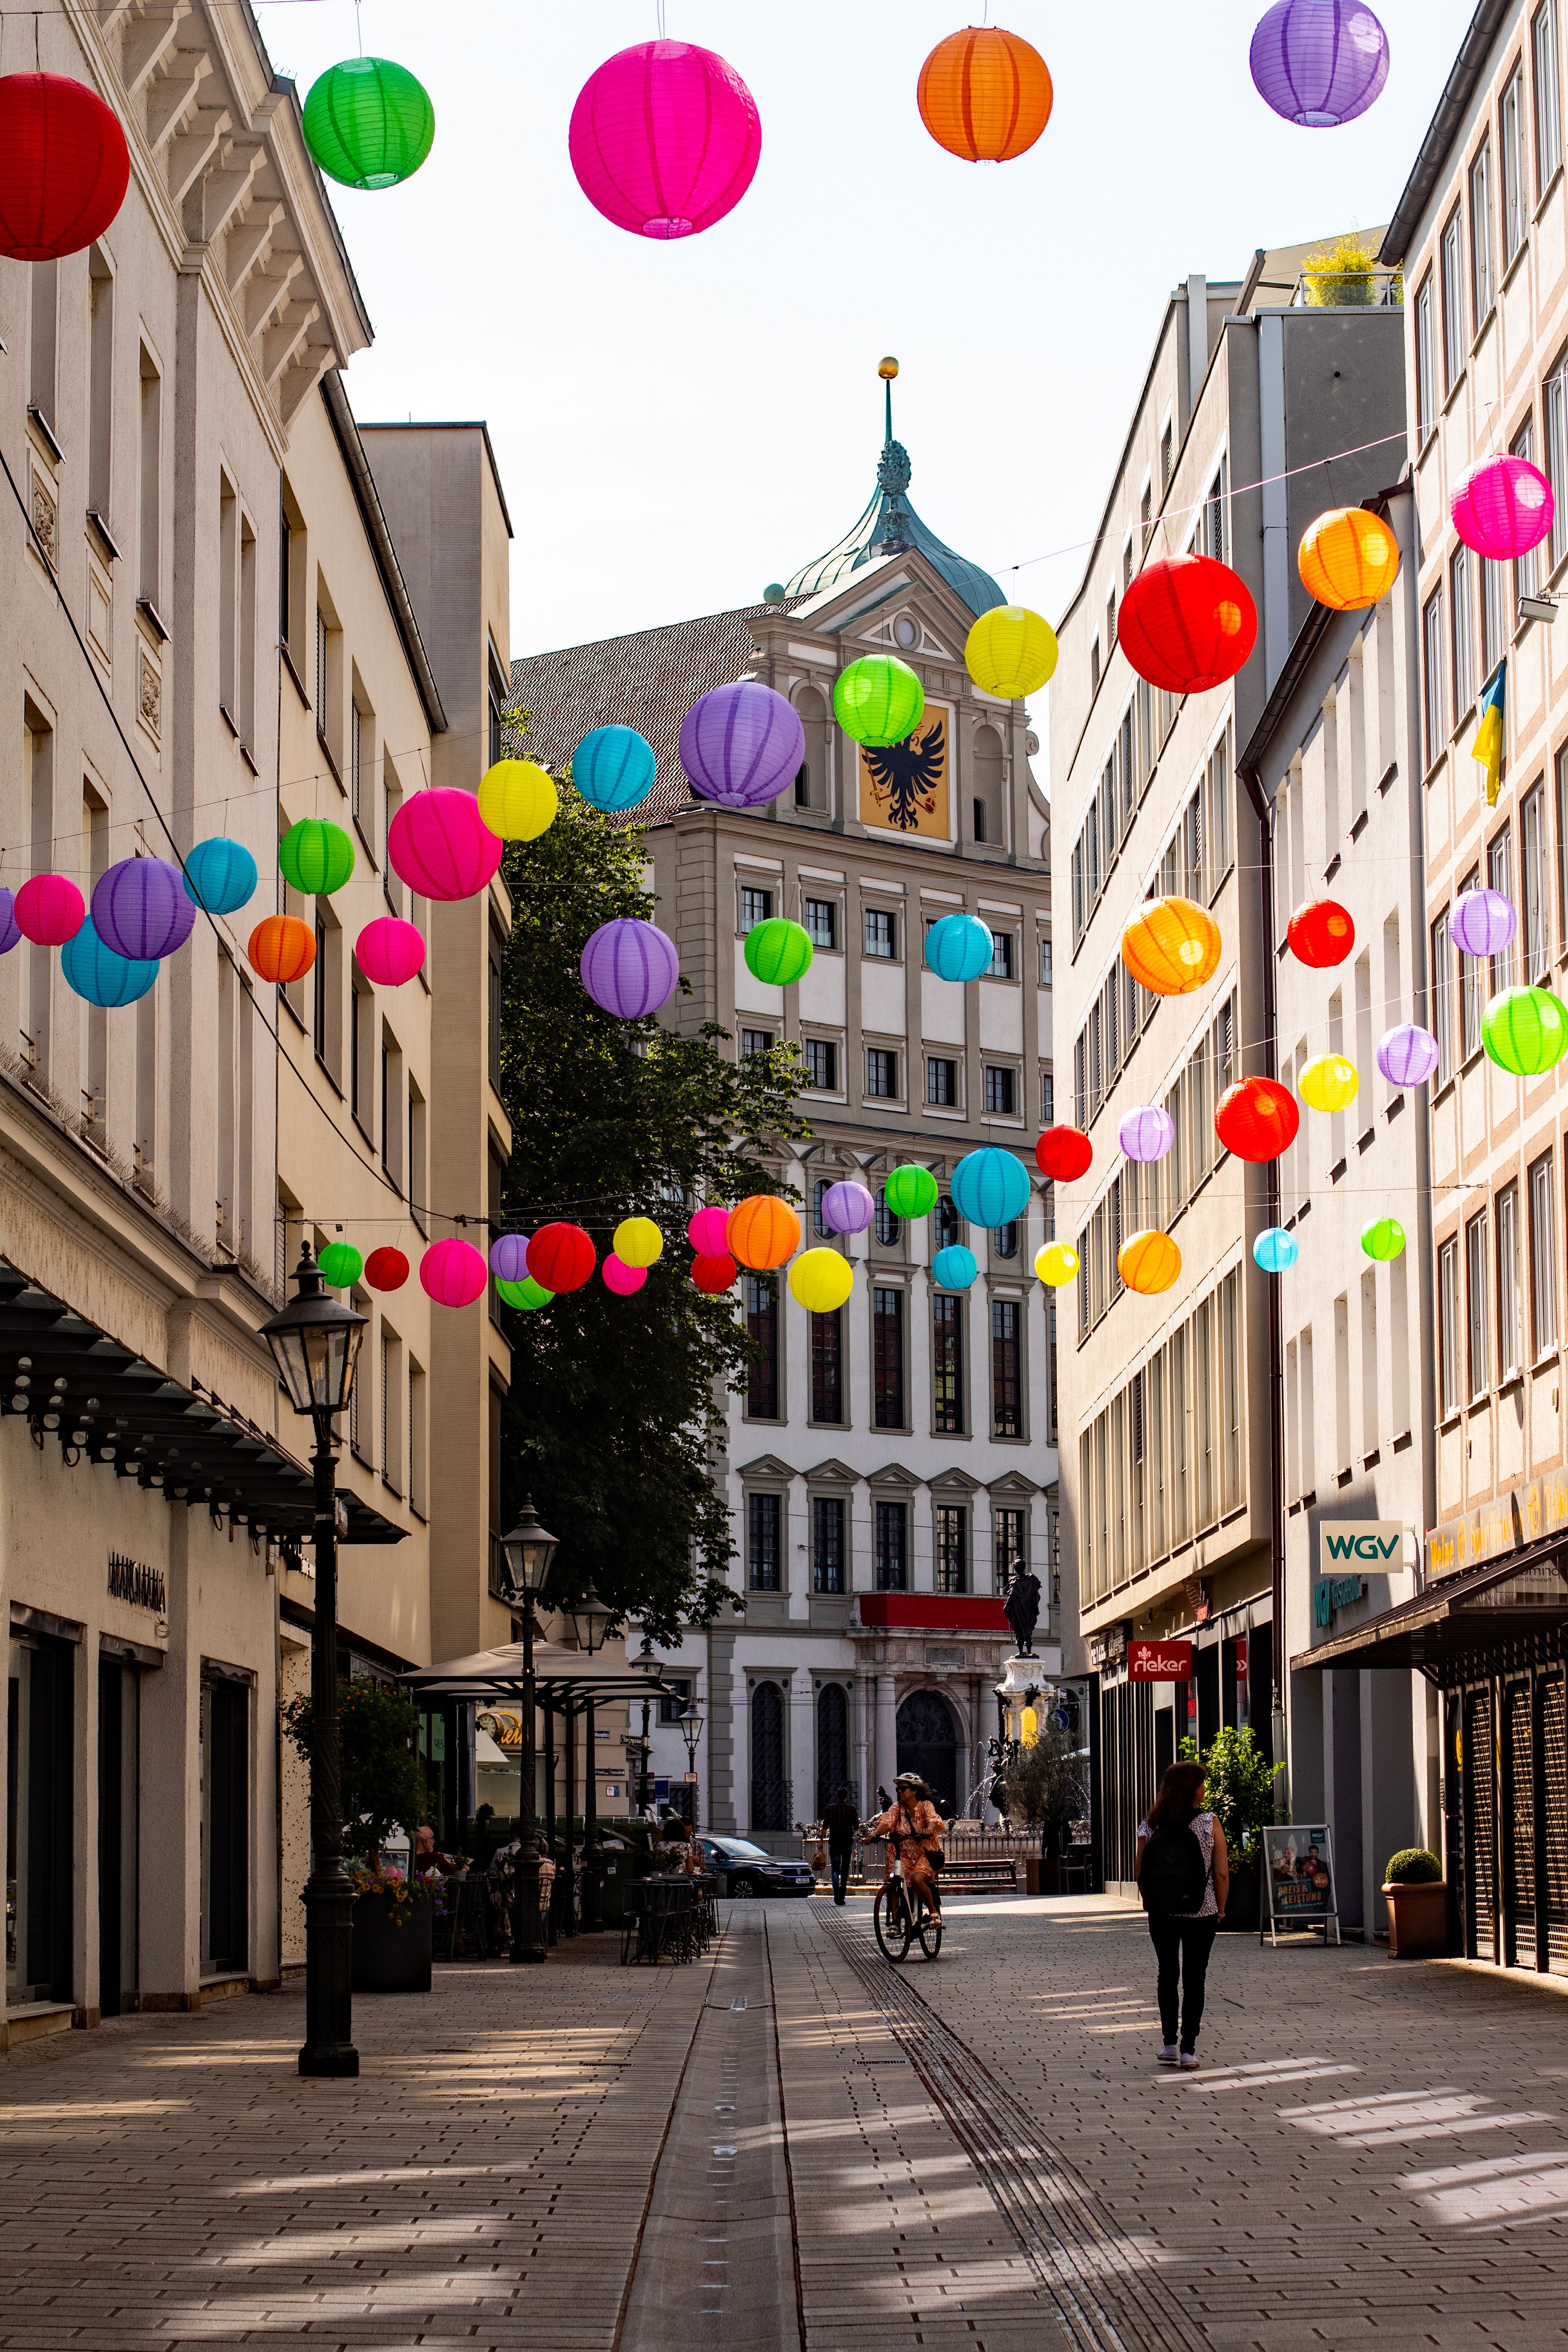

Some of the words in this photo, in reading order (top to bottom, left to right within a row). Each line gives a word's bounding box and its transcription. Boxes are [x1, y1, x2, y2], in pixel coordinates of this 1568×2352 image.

[1326, 1535, 1399, 1559] WGV
[1431, 1534, 1454, 1572] Weine
[1314, 1577, 1330, 1628] WGV
[1134, 1655, 1187, 1672] rieker
[1278, 1885, 1301, 1895] PREIS
[1284, 1892, 1321, 1904] LEISTUNG
